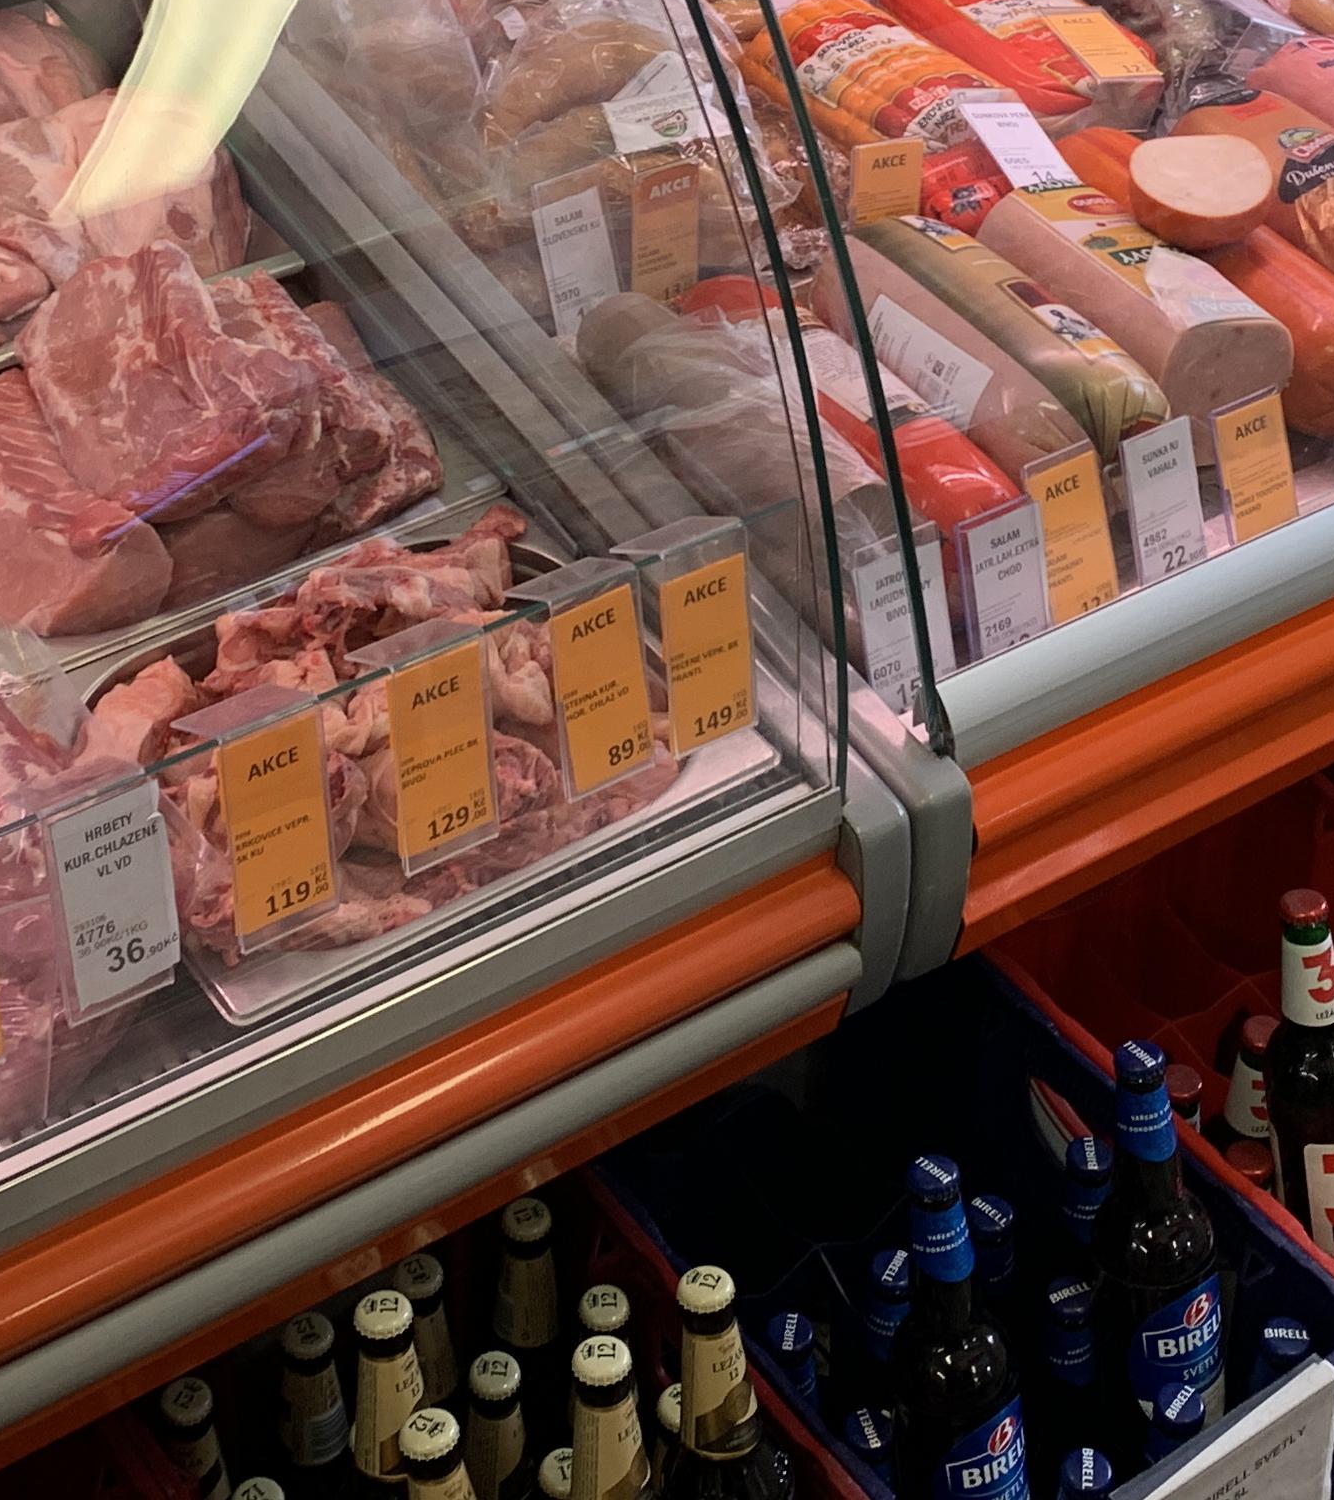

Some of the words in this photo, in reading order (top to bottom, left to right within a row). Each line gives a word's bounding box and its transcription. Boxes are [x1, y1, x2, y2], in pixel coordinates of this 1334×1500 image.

[871, 154, 907, 171] AKCE
[1235, 414, 1268, 441] AKCE
[1045, 474, 1081, 502] AKCE
[989, 528, 1022, 549] SALAM
[997, 562, 1023, 582] CHOD
[683, 576, 728, 607] AKCE
[571, 607, 617, 643] AKCE
[984, 616, 1012, 638] 2169
[872, 659, 902, 681] 6070
[411, 675, 460, 711] AKCE
[693, 705, 733, 738] 149
[247, 746, 300, 782] AKCE
[608, 738, 635, 767] 89
[85, 812, 134, 844] HRBETY
[427, 805, 470, 842] 129
[114, 855, 132, 872] VD
[265, 880, 311, 917] 119
[75, 920, 116, 947] 4776
